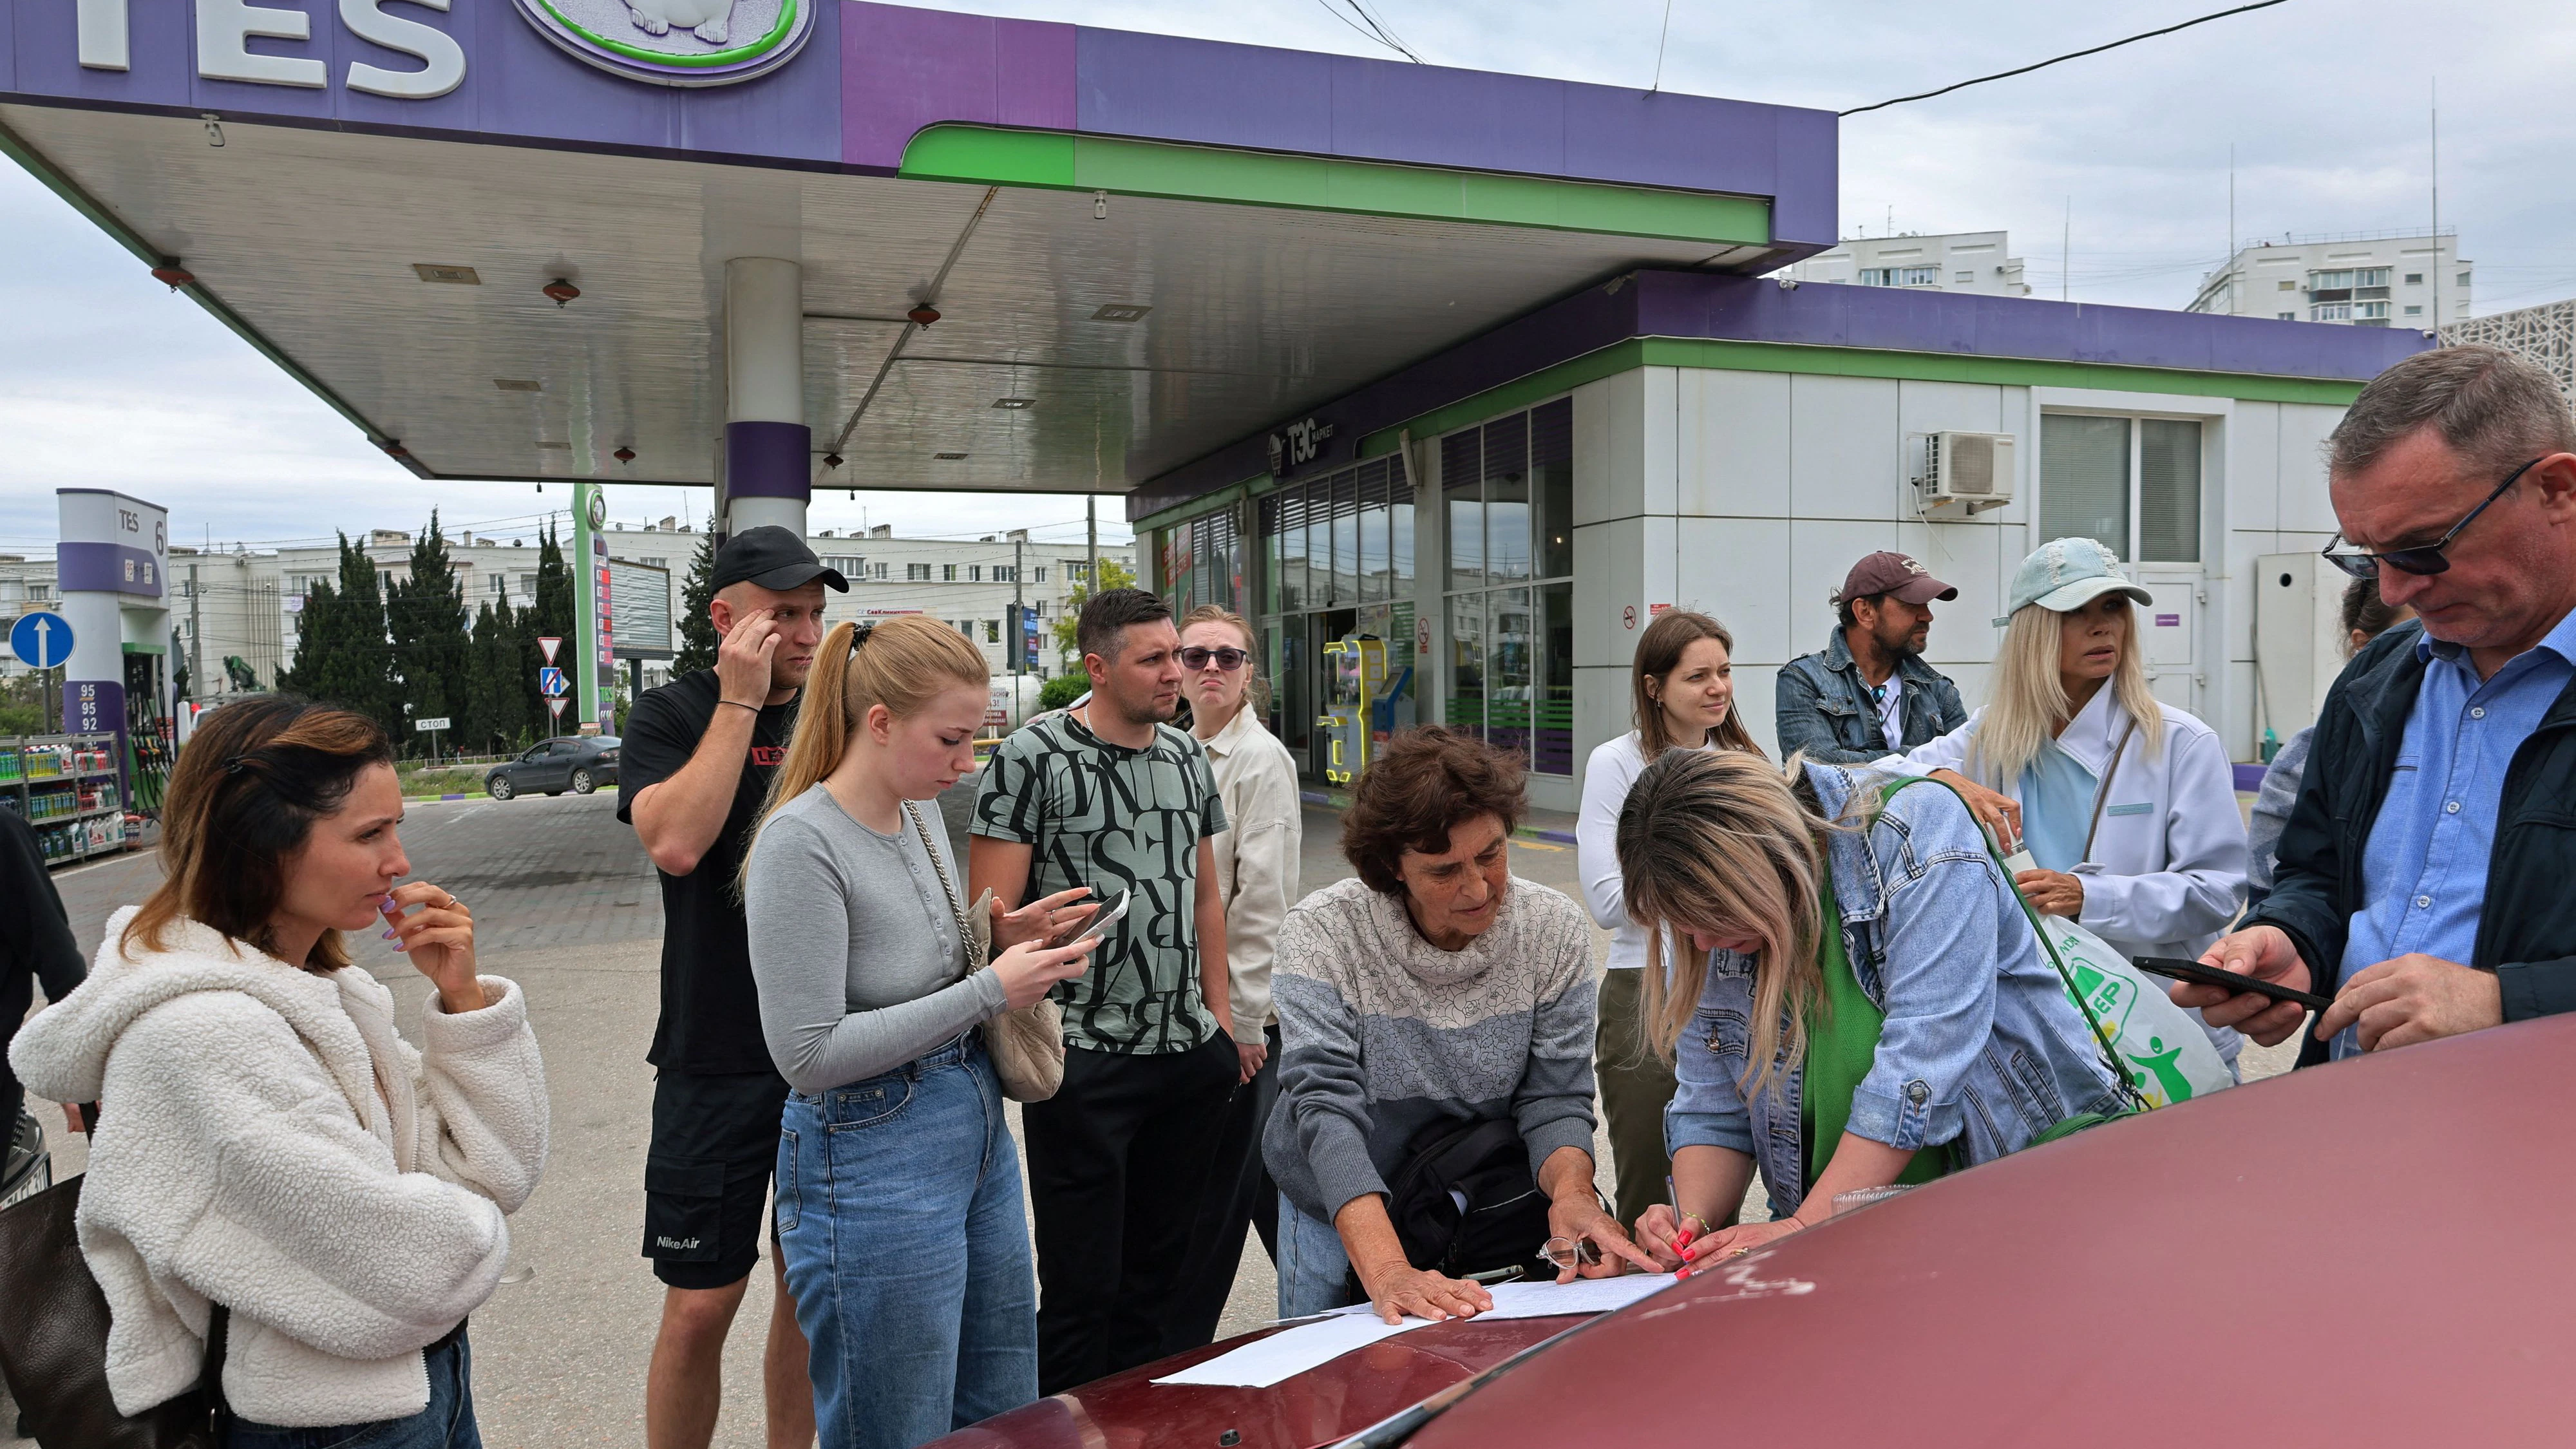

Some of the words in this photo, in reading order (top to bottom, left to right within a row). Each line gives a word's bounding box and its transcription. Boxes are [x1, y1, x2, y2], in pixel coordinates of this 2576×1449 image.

[1287, 417, 1316, 466] ТЭС
[1312, 424, 1333, 443] МАРКЕТ
[118, 509, 139, 533] TES
[156, 520, 164, 556] 6
[81, 685, 95, 697] 95
[600, 687, 613, 703] TES
[82, 702, 96, 715] 95
[82, 718, 97, 730] 92
[421, 719, 446, 728] СТОП
